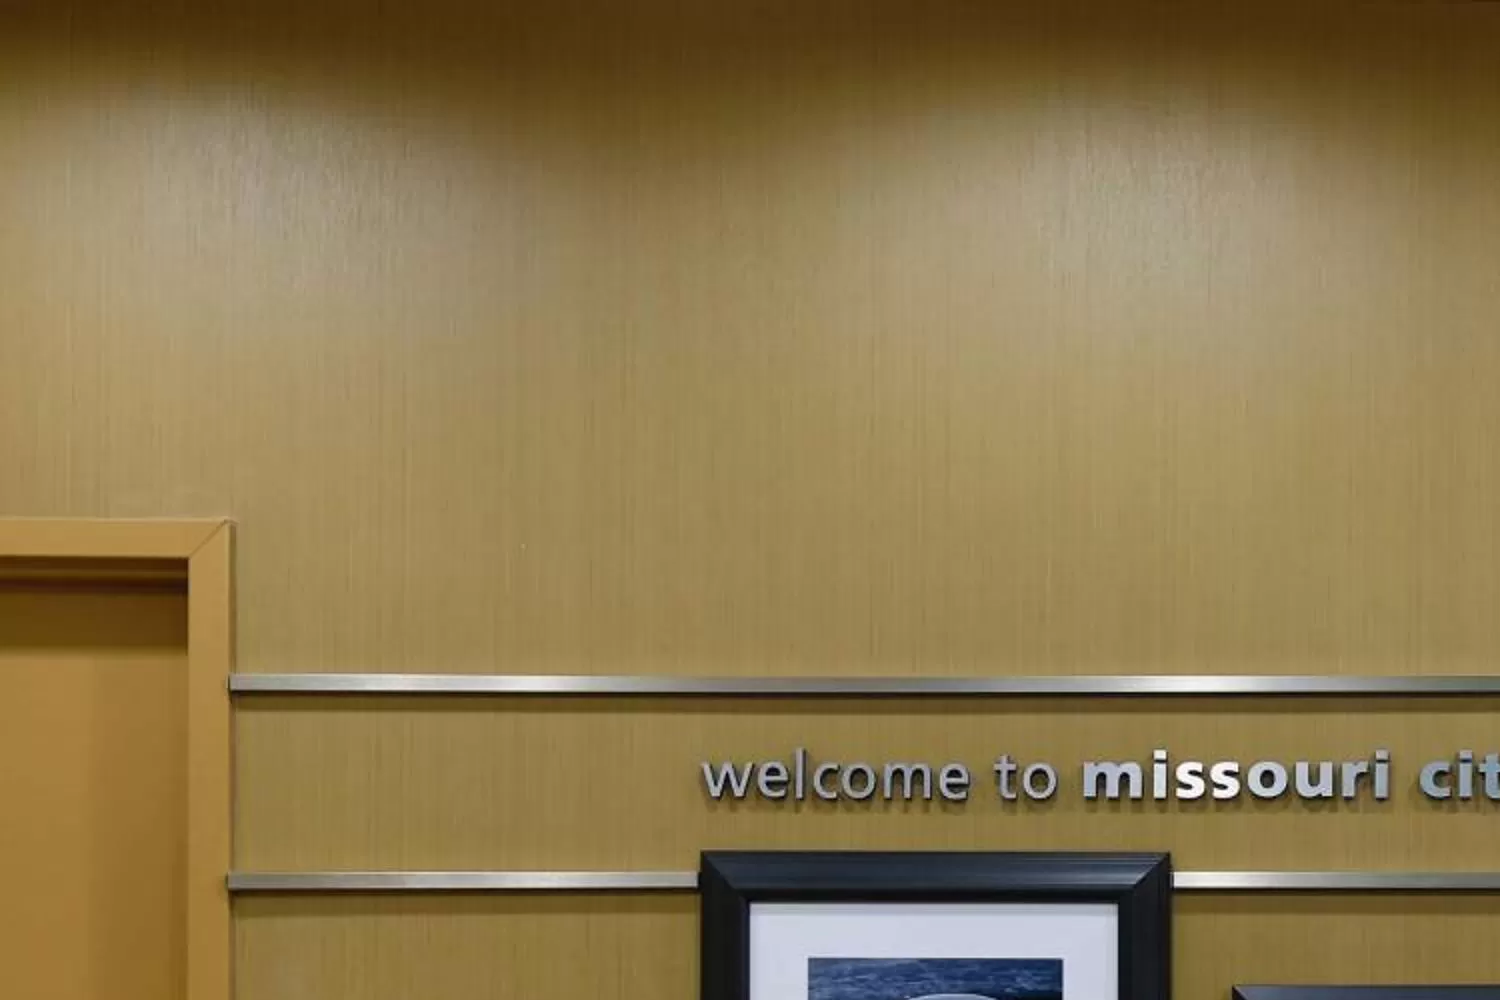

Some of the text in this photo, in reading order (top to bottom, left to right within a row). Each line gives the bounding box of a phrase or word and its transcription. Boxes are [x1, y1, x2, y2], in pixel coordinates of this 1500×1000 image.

[702, 747, 970, 800] welcome
[994, 753, 1059, 800] to
[1082, 749, 1391, 800] missouri
